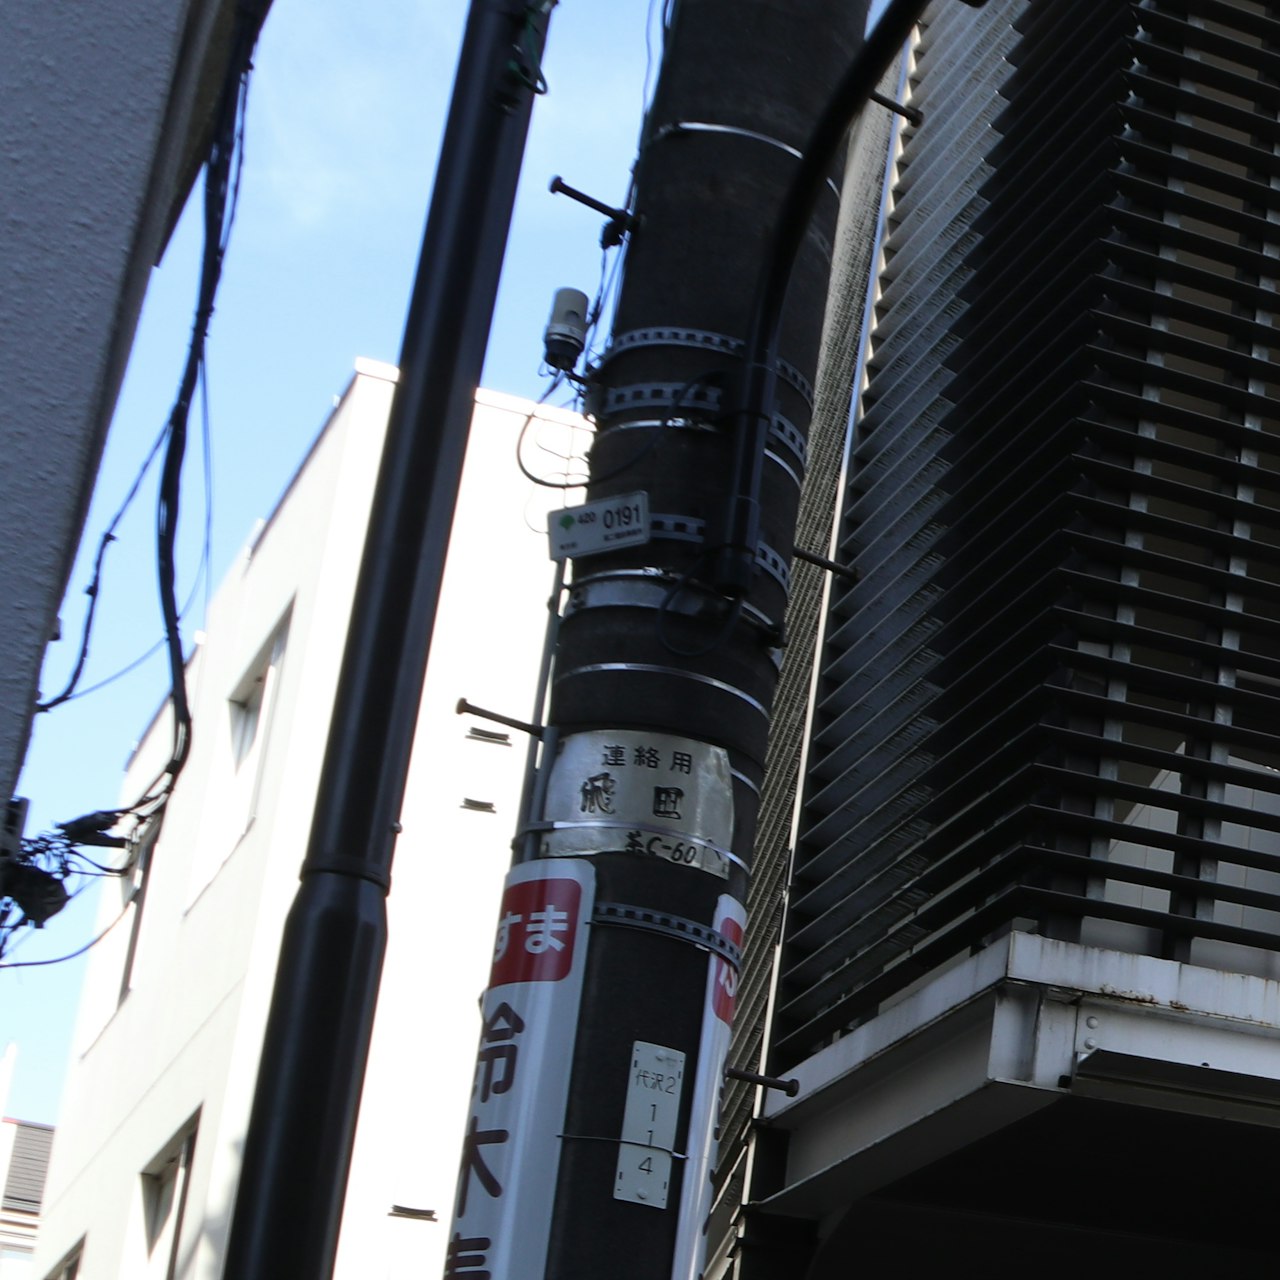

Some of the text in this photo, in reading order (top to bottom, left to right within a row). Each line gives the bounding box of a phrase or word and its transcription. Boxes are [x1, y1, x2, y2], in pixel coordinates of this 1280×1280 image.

[603, 504, 641, 529] 0191
[602, 745, 693, 775] 連絡用
[635, 1069, 677, 1095] 代沢2
[638, 1156, 654, 1175] 4
